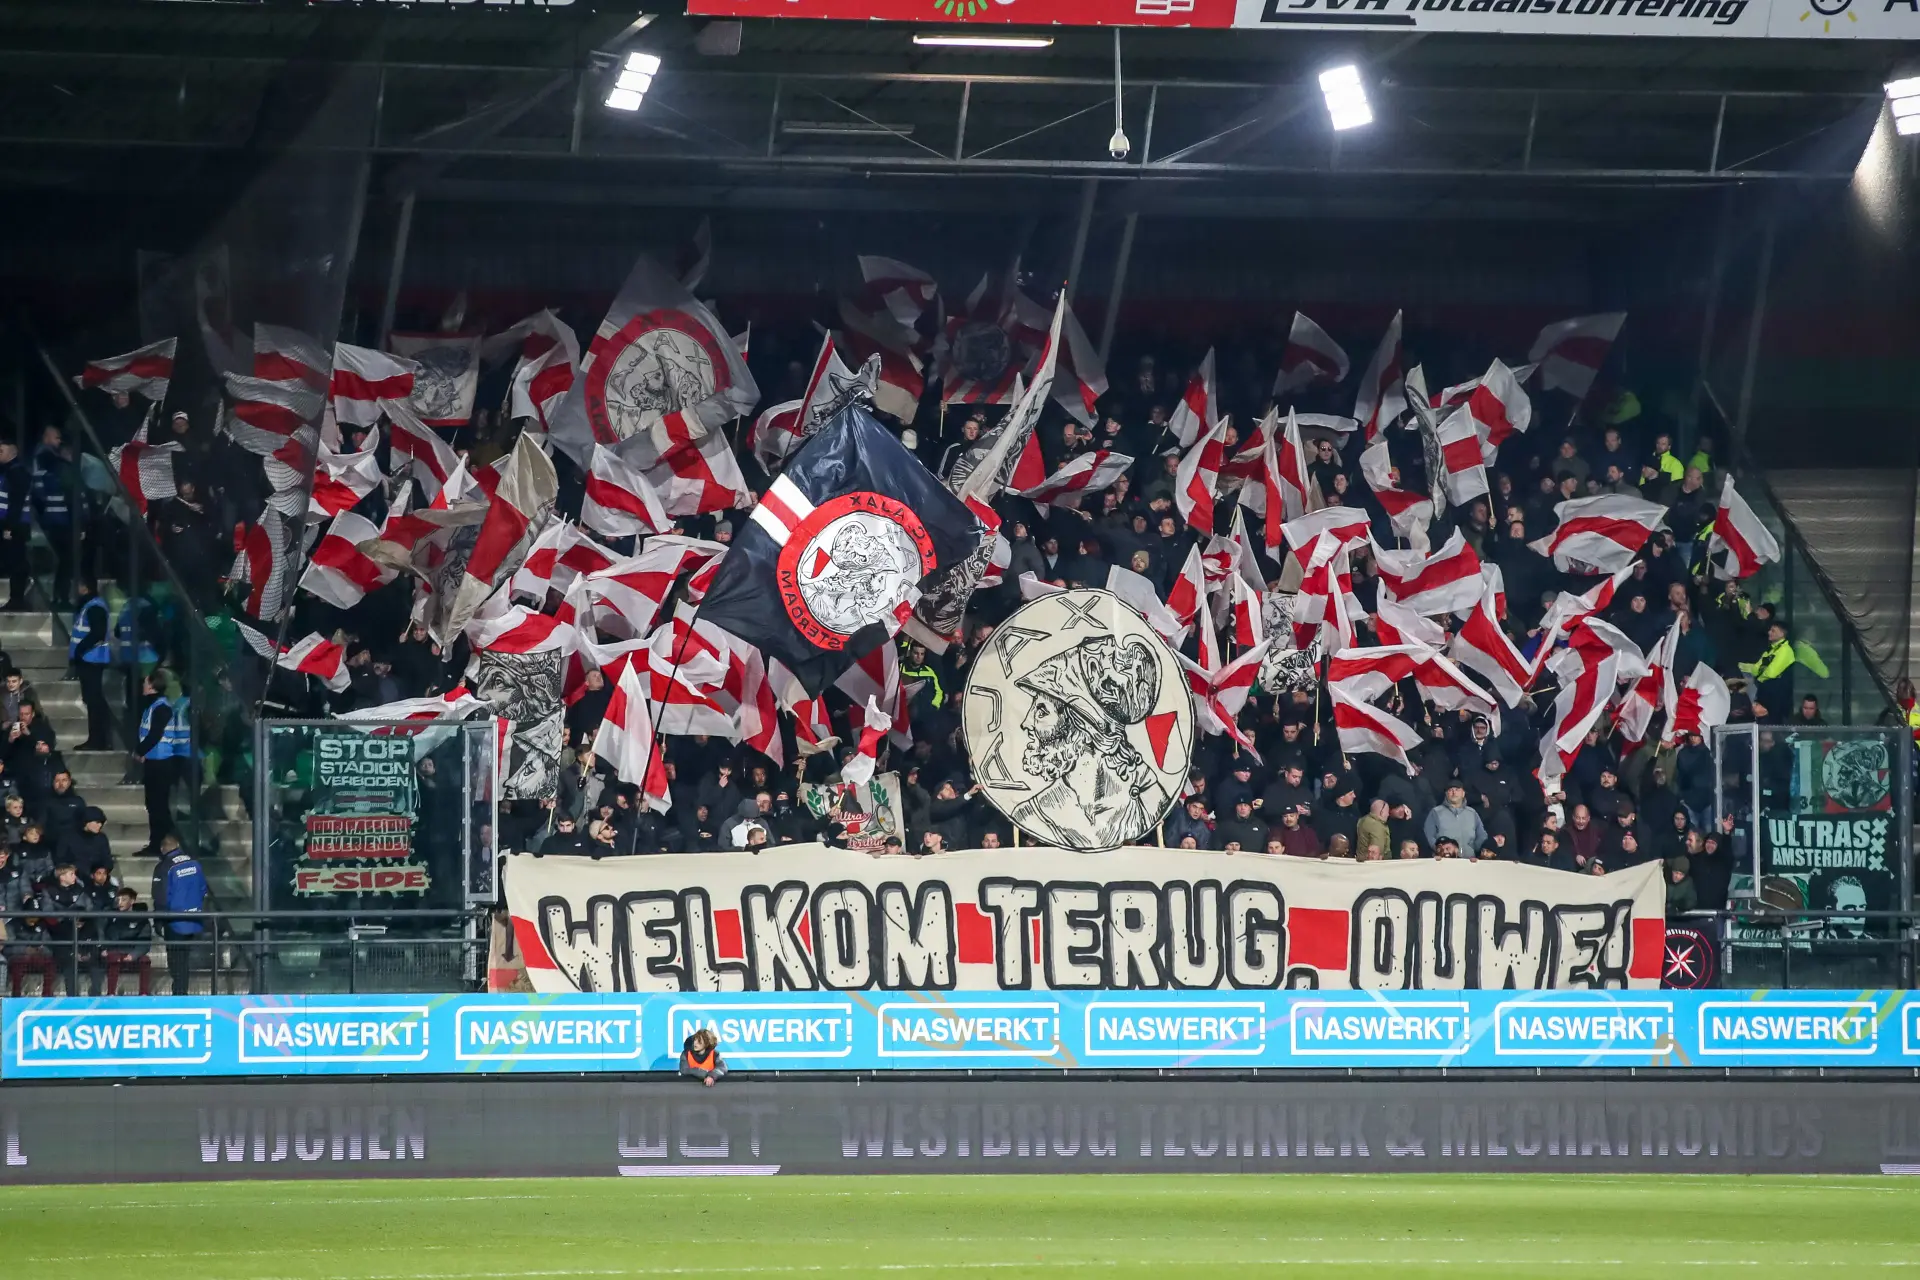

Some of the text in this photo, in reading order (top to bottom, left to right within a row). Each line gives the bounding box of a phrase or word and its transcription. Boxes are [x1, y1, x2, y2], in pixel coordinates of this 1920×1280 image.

[970, 595, 1108, 791] AJAX
[320, 739, 409, 759] STOP
[320, 761, 410, 774] STADION
[319, 776, 409, 788] VERBODEN
[311, 836, 362, 853] NEVER
[1768, 819, 1871, 849] ULTRAS
[1772, 847, 1867, 868] AMSTERDAM
[297, 871, 426, 890] F-SIDE
[538, 879, 957, 992] WELKOM
[1350, 886, 1634, 991] OUWE!
[200, 1105, 425, 1163] WIJCHEN
[841, 1102, 1117, 1157] WESTBRUG
[1136, 1102, 1370, 1157] TECHNIEK
[1385, 1102, 1426, 1157] &
[1441, 1102, 1825, 1157] MECHATRONICS
